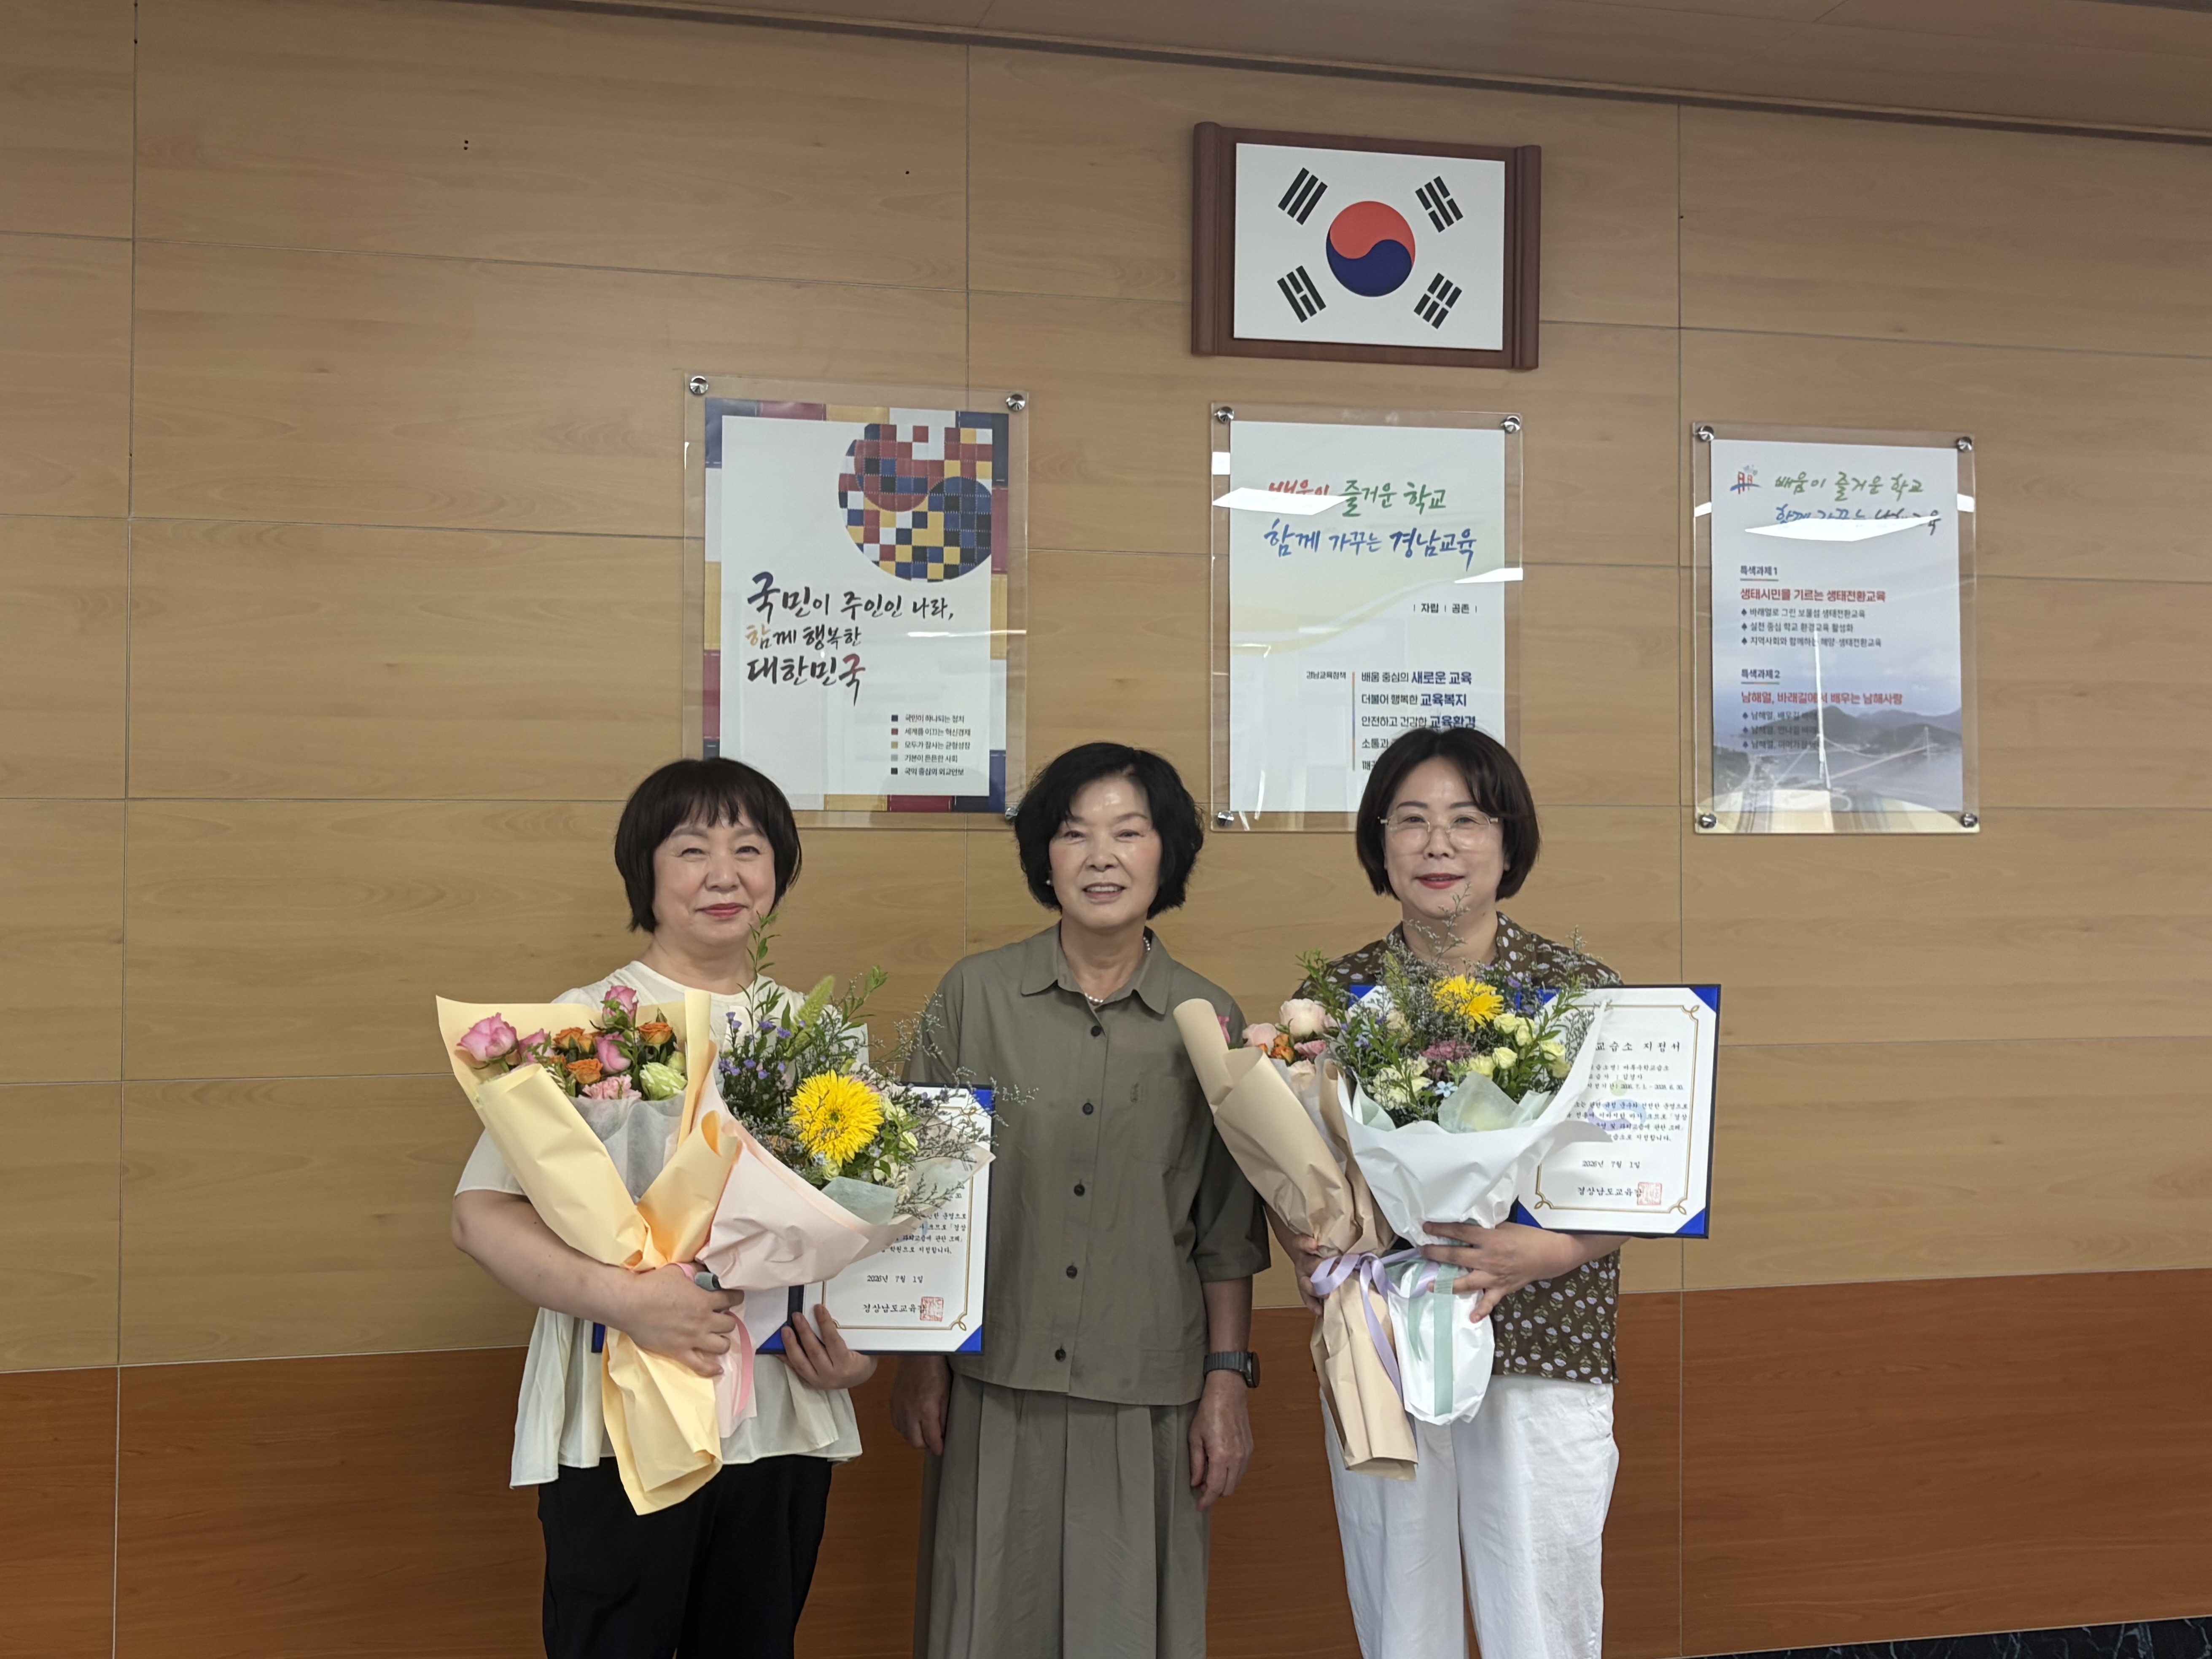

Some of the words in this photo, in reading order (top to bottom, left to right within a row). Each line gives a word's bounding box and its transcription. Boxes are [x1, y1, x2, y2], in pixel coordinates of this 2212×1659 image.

[1775, 471, 1826, 495] 배움이
[1834, 471, 1883, 502] 즐거운
[1890, 474, 1924, 502] 학교
[1338, 479, 1397, 517] 즐거운
[1403, 482, 1446, 515] 학교
[1264, 518, 1320, 557] 함께
[1329, 530, 1383, 556] 가꾸는
[1389, 527, 1477, 572] 경남교육
[747, 571, 829, 624] 국민이
[841, 591, 902, 620] 주인인
[912, 597, 953, 620] 나라,
[1741, 588, 1790, 601] 생태시민을
[1794, 589, 1824, 601] 기르는
[1827, 590, 1886, 602] 생태전환교육
[1421, 603, 1439, 613] 자립
[1452, 603, 1469, 614] 공존
[1781, 608, 1796, 618] 그린
[1822, 609, 1865, 619] 생태전환교육
[1750, 622, 1765, 632] 실천
[1767, 622, 1781, 632] 중심
[1784, 622, 1798, 632] 학교
[1801, 623, 1829, 632] 환경교육
[1832, 623, 1853, 633] 활성화
[745, 624, 797, 649] 함께
[802, 624, 861, 650] 행복한
[1750, 636, 1787, 646] 지역사회와
[747, 653, 866, 707] 대한민국
[1361, 671, 1379, 683] 배움
[1382, 672, 1409, 683] 중심의
[1411, 671, 1446, 685] 새로운
[1449, 671, 1472, 685] 교육
[1361, 694, 1389, 705] 더불어
[1391, 694, 1418, 705] 행복한
[1420, 694, 1467, 707] 교육복지
[1831, 693, 1860, 704] 배우는
[1863, 693, 1903, 705] 남해사랑
[1361, 716, 1398, 727] 안전하고
[1400, 716, 1427, 728] 건강한
[1430, 715, 1476, 729] 교육환경
[1362, 738, 1389, 749] 소통과
[1644, 1041, 1680, 1052] 지정서
